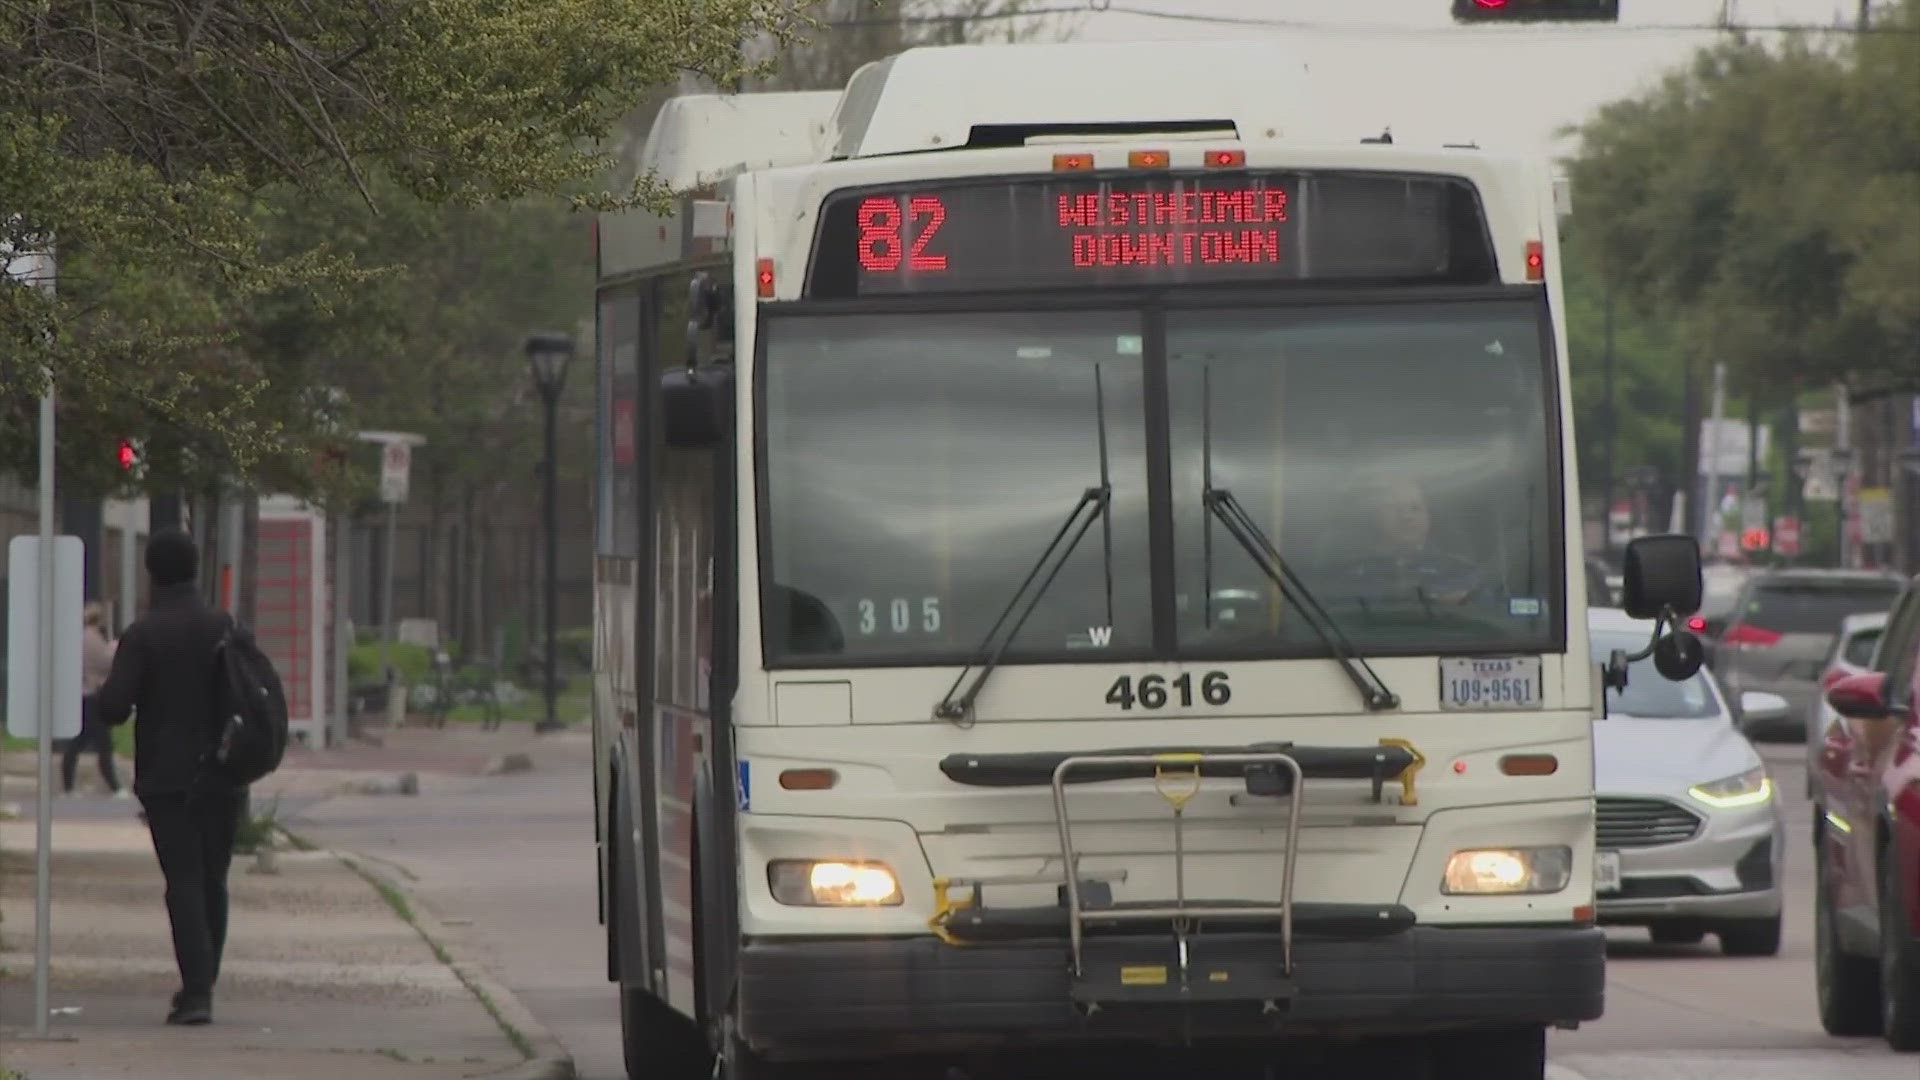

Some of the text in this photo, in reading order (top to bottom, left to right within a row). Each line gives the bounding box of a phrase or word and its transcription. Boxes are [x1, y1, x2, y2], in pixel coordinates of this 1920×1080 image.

[1058, 190, 1287, 226] WESTHEIMER
[858, 198, 947, 270] 82
[1073, 230, 1279, 266] DOWNTOWN
[859, 597, 940, 633] 305
[1088, 626, 1112, 647] W
[1472, 662, 1511, 672] TEXAS
[1105, 671, 1231, 710] 4616
